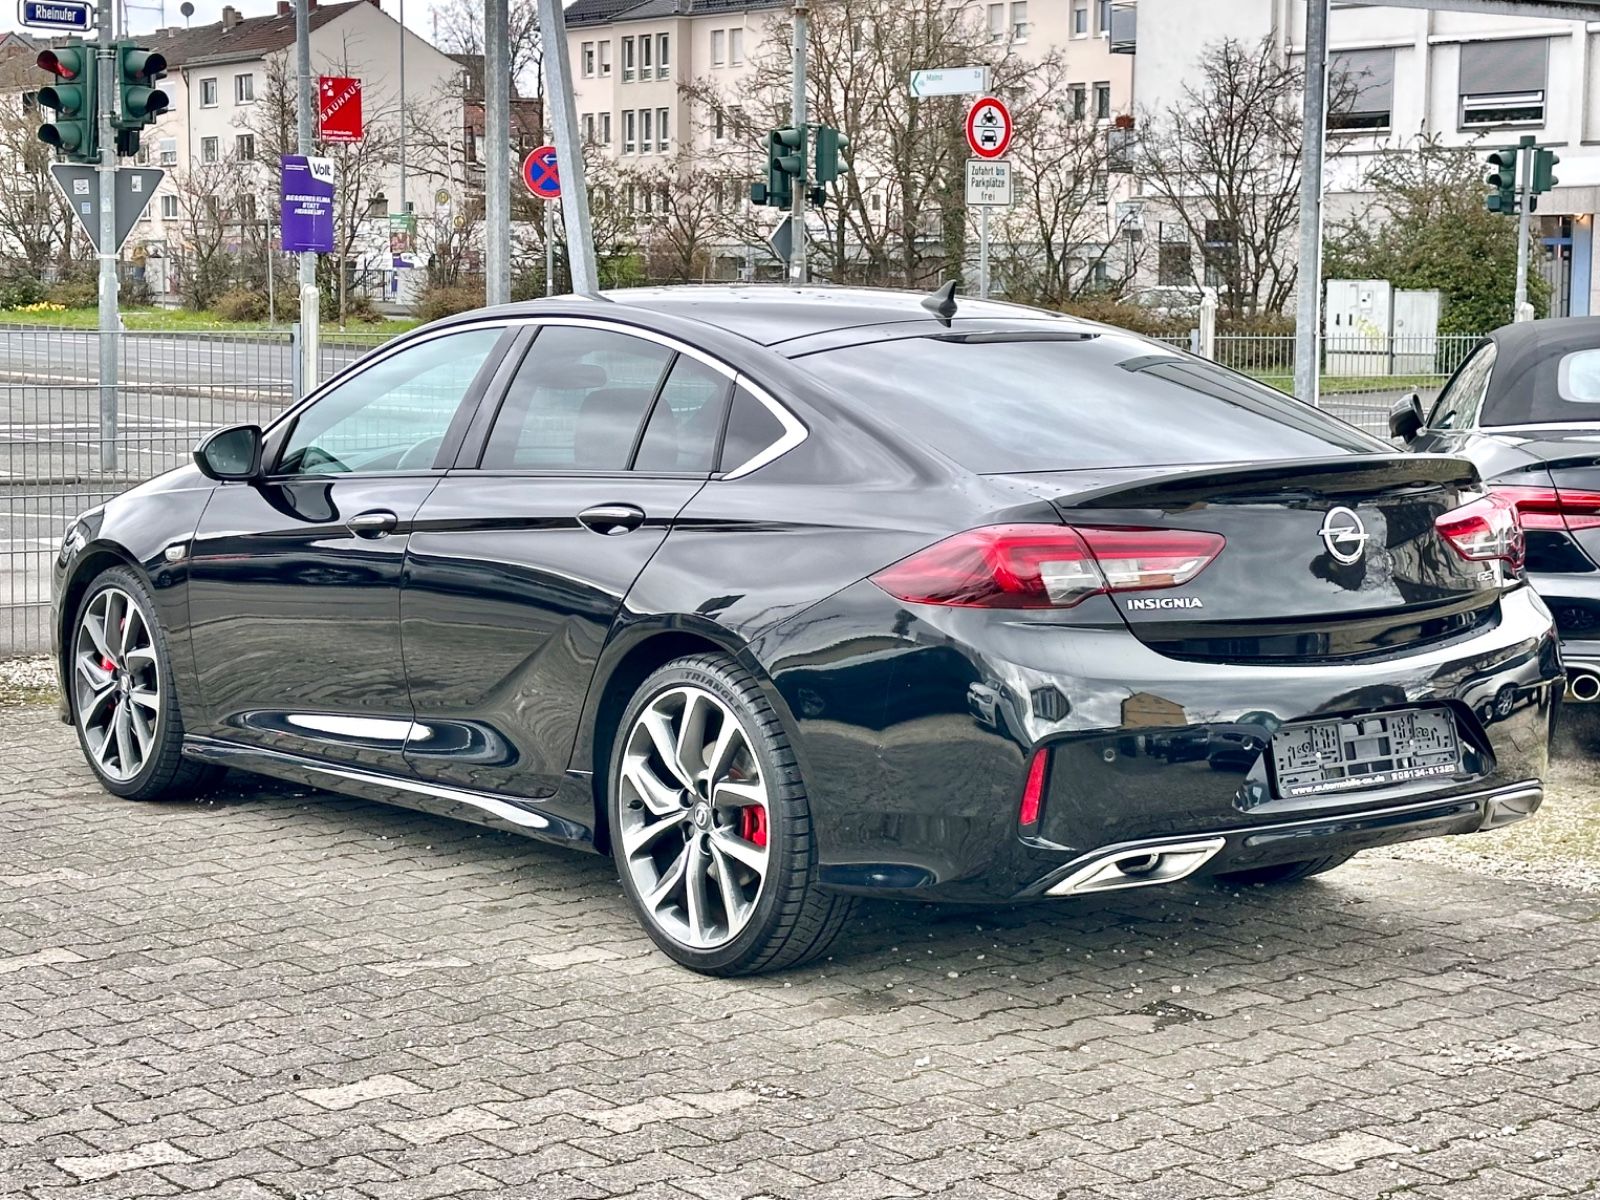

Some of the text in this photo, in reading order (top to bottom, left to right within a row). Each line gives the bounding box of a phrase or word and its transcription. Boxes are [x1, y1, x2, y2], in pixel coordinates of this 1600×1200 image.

[35, 4, 77, 22] Rheinufer
[320, 80, 362, 122] BAUHAUS
[312, 163, 331, 176] Volt
[971, 165, 994, 176] Zufahrt
[971, 177, 1005, 190] Parkplätze
[981, 191, 996, 201] frei
[1127, 597, 1203, 610] INSIGNIA
[684, 671, 745, 716] TRIANGLE
